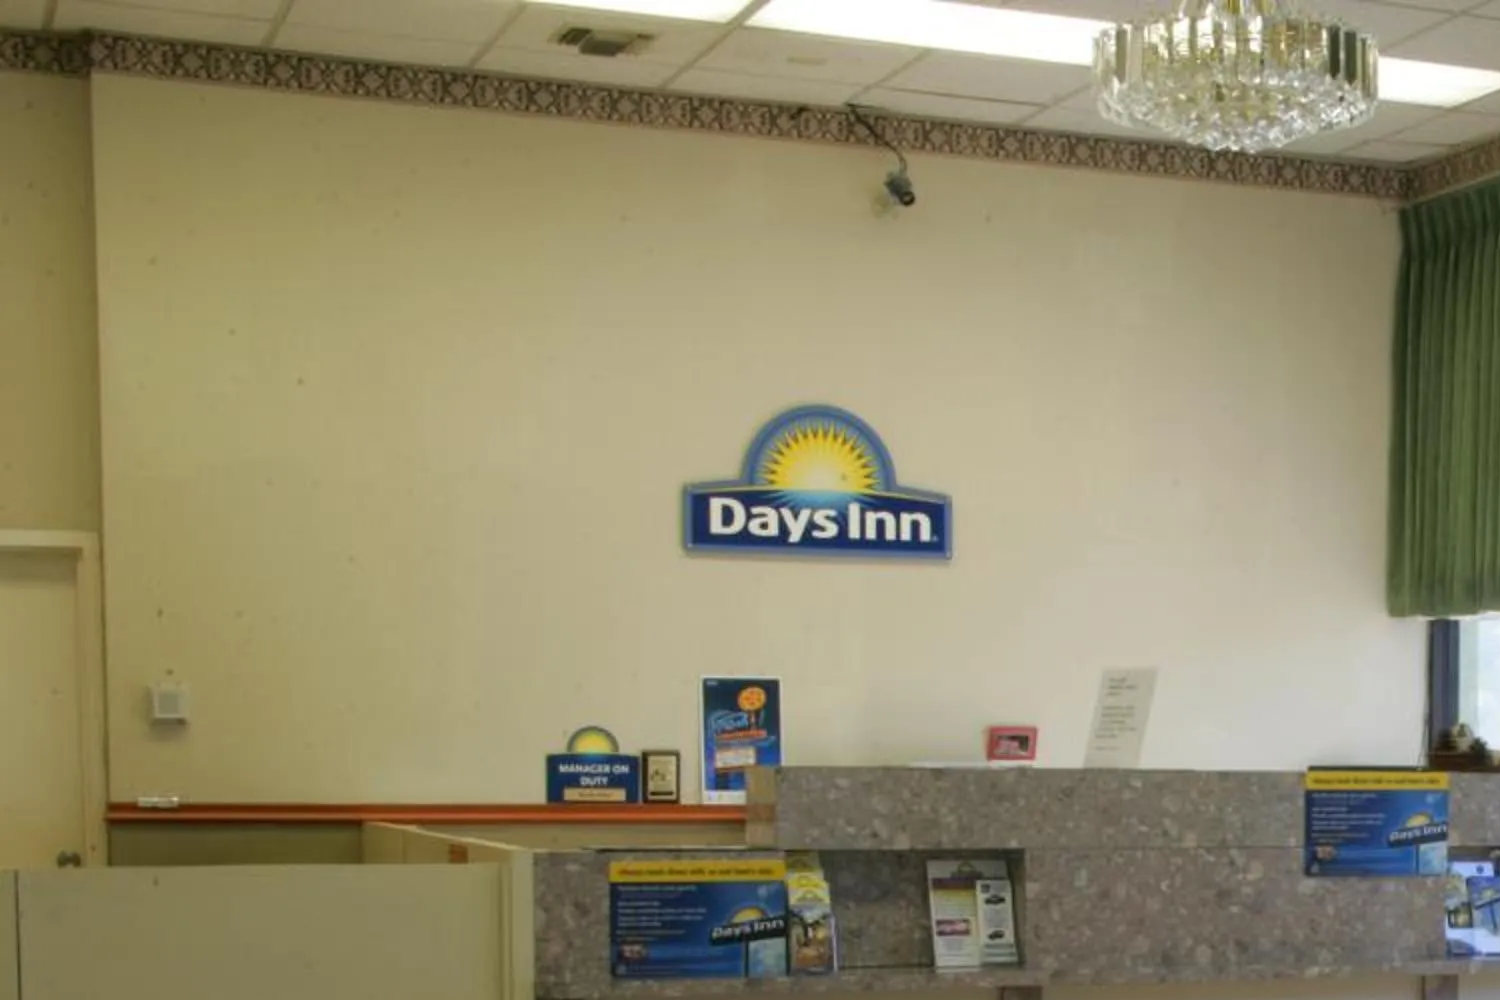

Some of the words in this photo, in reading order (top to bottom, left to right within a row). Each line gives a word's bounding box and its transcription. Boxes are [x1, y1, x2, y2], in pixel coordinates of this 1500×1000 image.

[708, 496, 839, 543] Days
[847, 502, 932, 542] Inn
[559, 763, 610, 773] MANAGER
[611, 764, 629, 774] ON
[579, 776, 609, 786] DUTY
